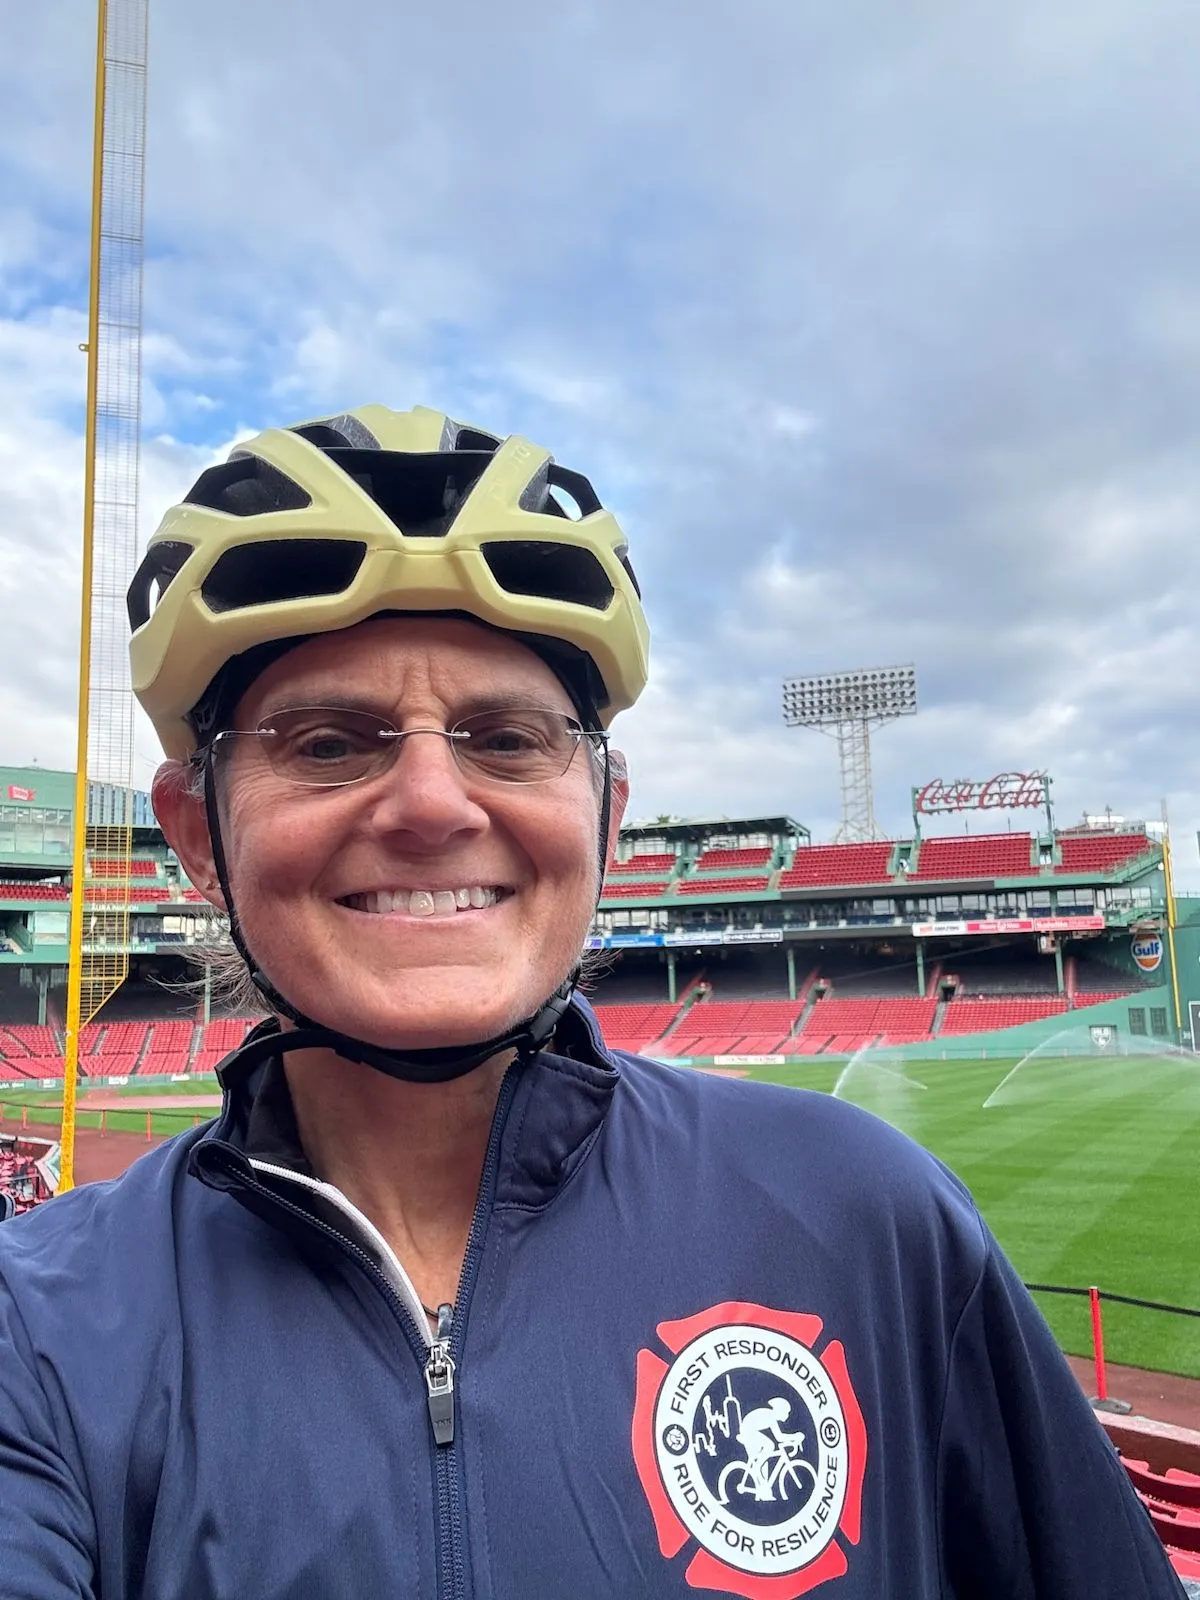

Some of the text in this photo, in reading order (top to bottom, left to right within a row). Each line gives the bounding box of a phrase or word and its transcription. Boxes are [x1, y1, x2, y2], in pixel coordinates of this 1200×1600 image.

[1133, 942, 1160, 956] Gulf
[671, 1340, 828, 1414] FIRST RESPONDER
[674, 1455, 838, 1557] RIDE FOR RESILIENCE
